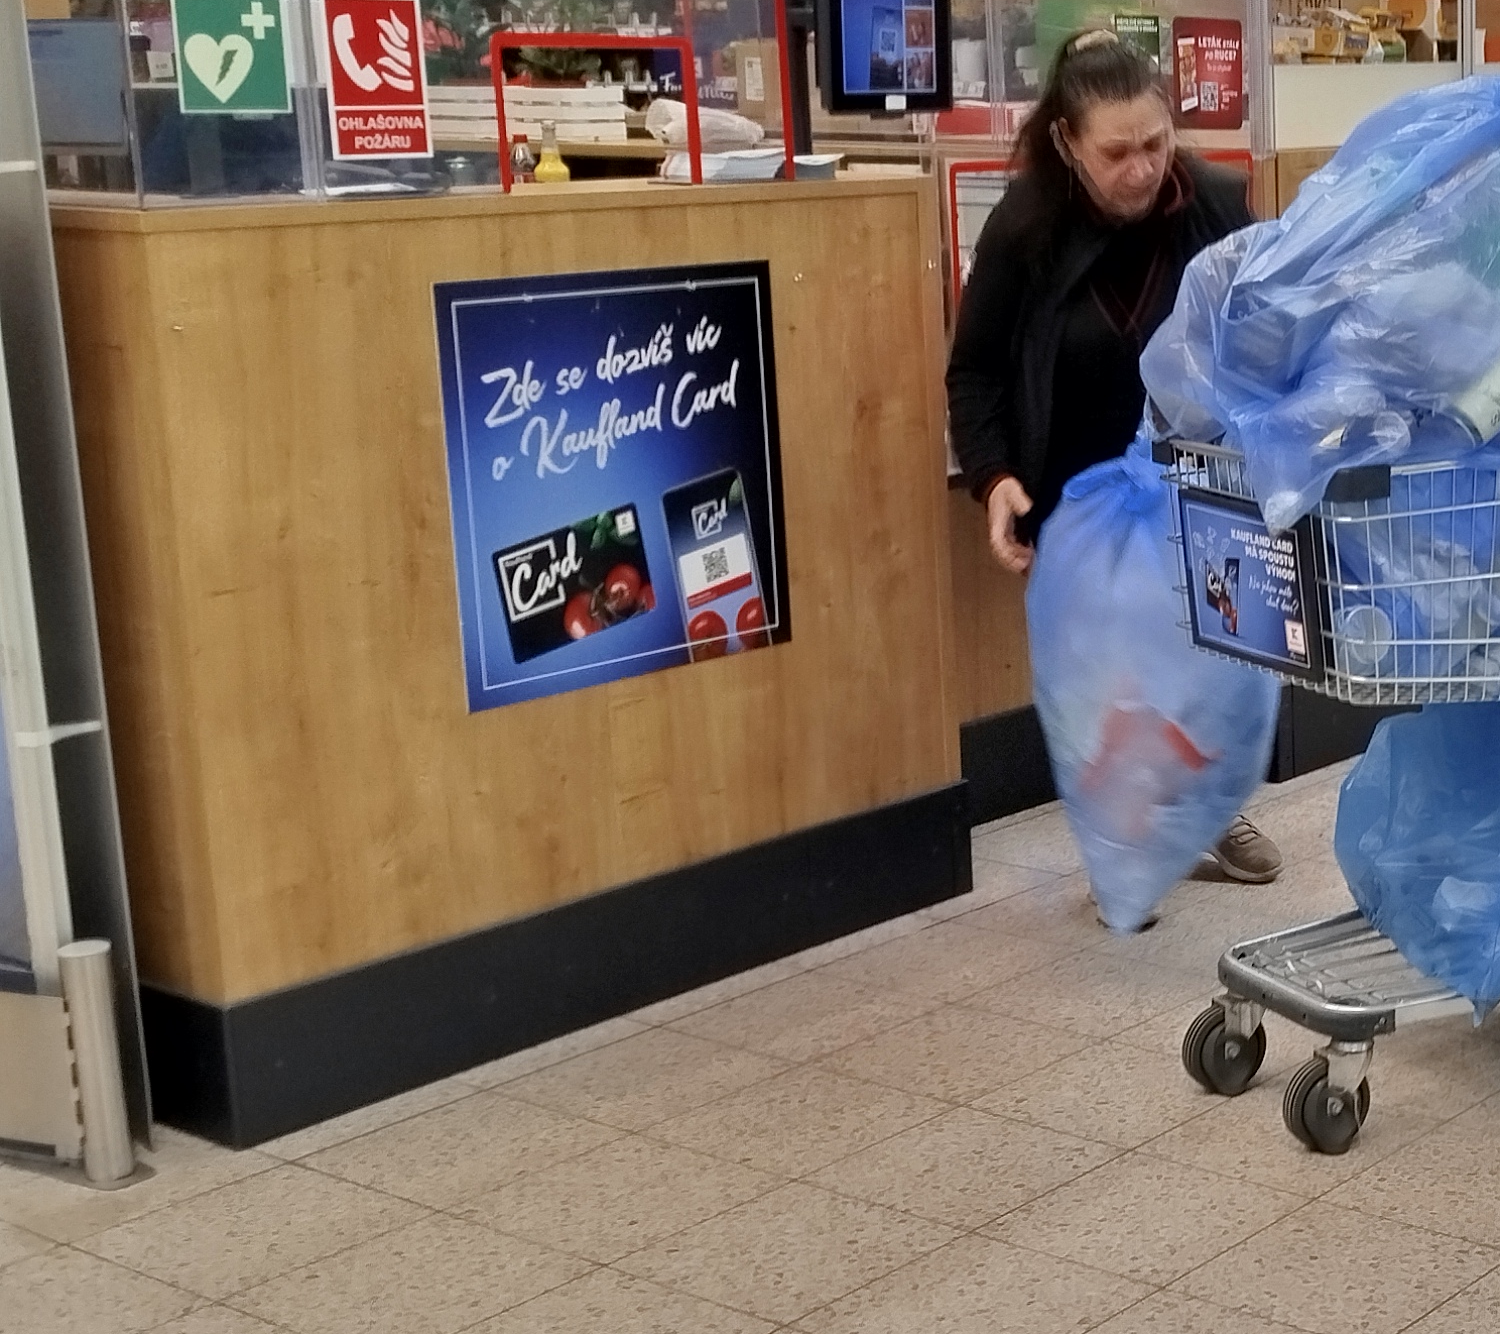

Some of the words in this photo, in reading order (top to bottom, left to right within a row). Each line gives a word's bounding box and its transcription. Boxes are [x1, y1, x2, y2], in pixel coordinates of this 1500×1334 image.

[338, 112, 424, 131] OHLAŠOVNA
[355, 133, 411, 150] POŽÁRU
[481, 360, 545, 429] Zde
[555, 365, 588, 395] se
[596, 323, 675, 384] dozvíš
[686, 314, 722, 355] víc
[491, 455, 514, 481] o
[520, 383, 666, 479] Kaufland
[670, 358, 740, 428] Card
[697, 497, 729, 534] Card
[1231, 528, 1271, 548] KAUFLAND
[511, 529, 584, 612] Card
[1258, 549, 1295, 568] SPOUSTU
